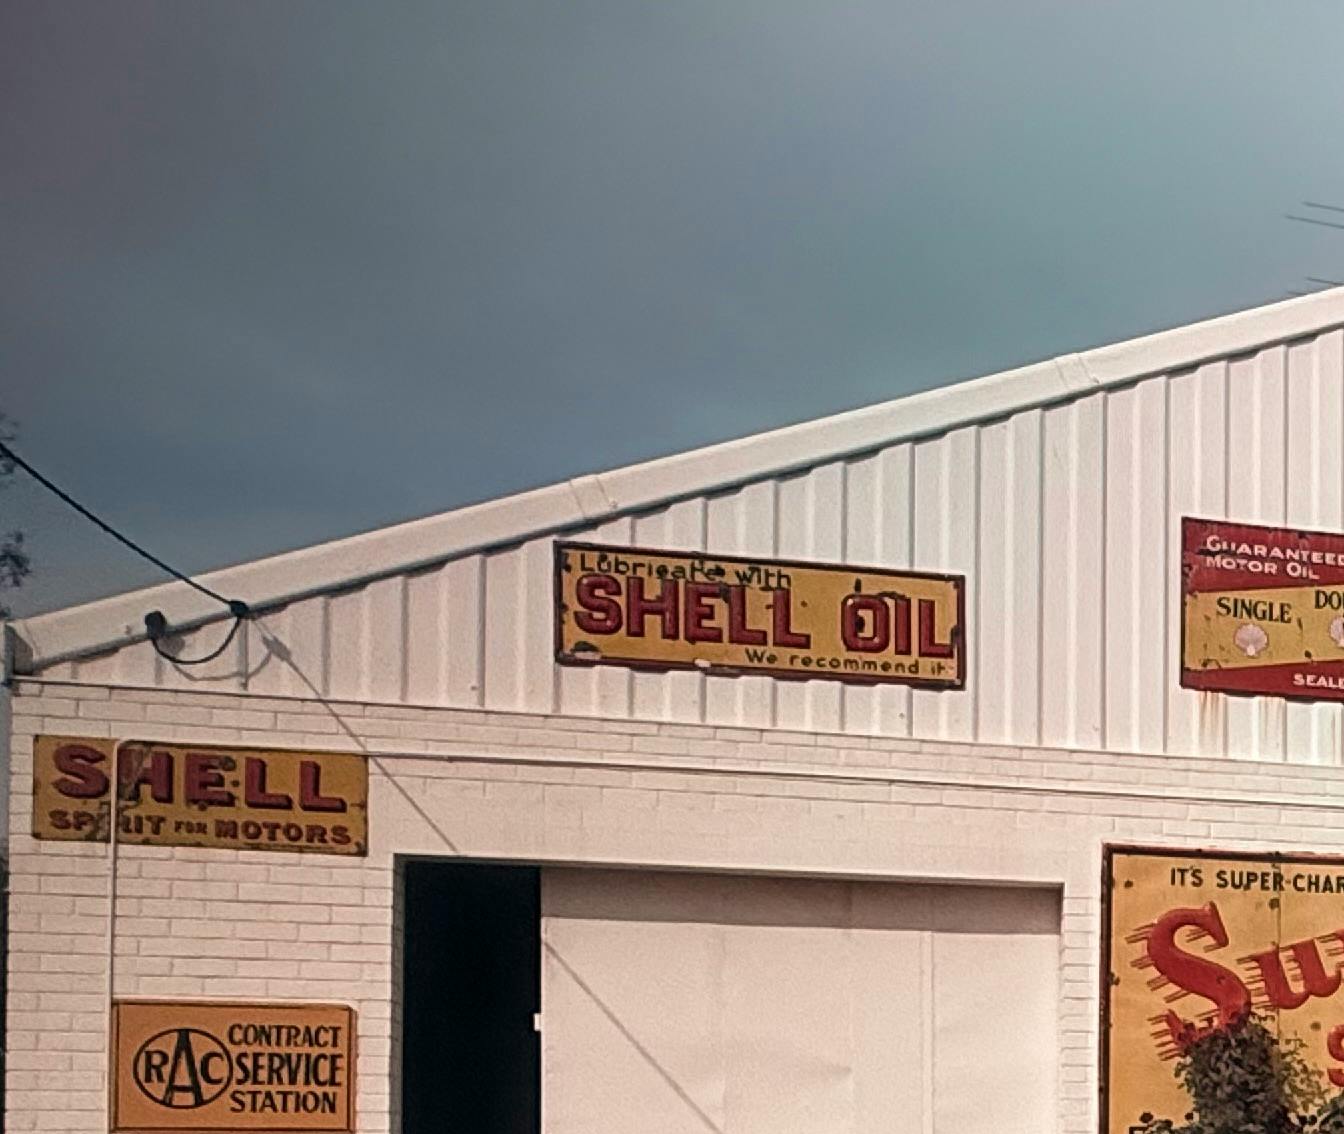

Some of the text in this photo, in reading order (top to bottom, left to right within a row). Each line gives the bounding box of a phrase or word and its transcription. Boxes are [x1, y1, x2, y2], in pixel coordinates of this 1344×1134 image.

[579, 552, 791, 588] Lubricate with
[1206, 554, 1320, 580] MOTOR OIL
[572, 573, 955, 659] SHELL OIL
[1216, 596, 1292, 624] SINGLE
[745, 648, 778, 665] We
[789, 653, 920, 675] recommend
[52, 743, 348, 813] SHELL
[174, 819, 208, 834] FOR
[214, 818, 351, 845] MOTORS
[1170, 866, 1204, 888] IT'S
[143, 1023, 342, 1107] RAC CONTRACT
[235, 1051, 344, 1087] SERVICE
[229, 1090, 338, 1114] STATION
